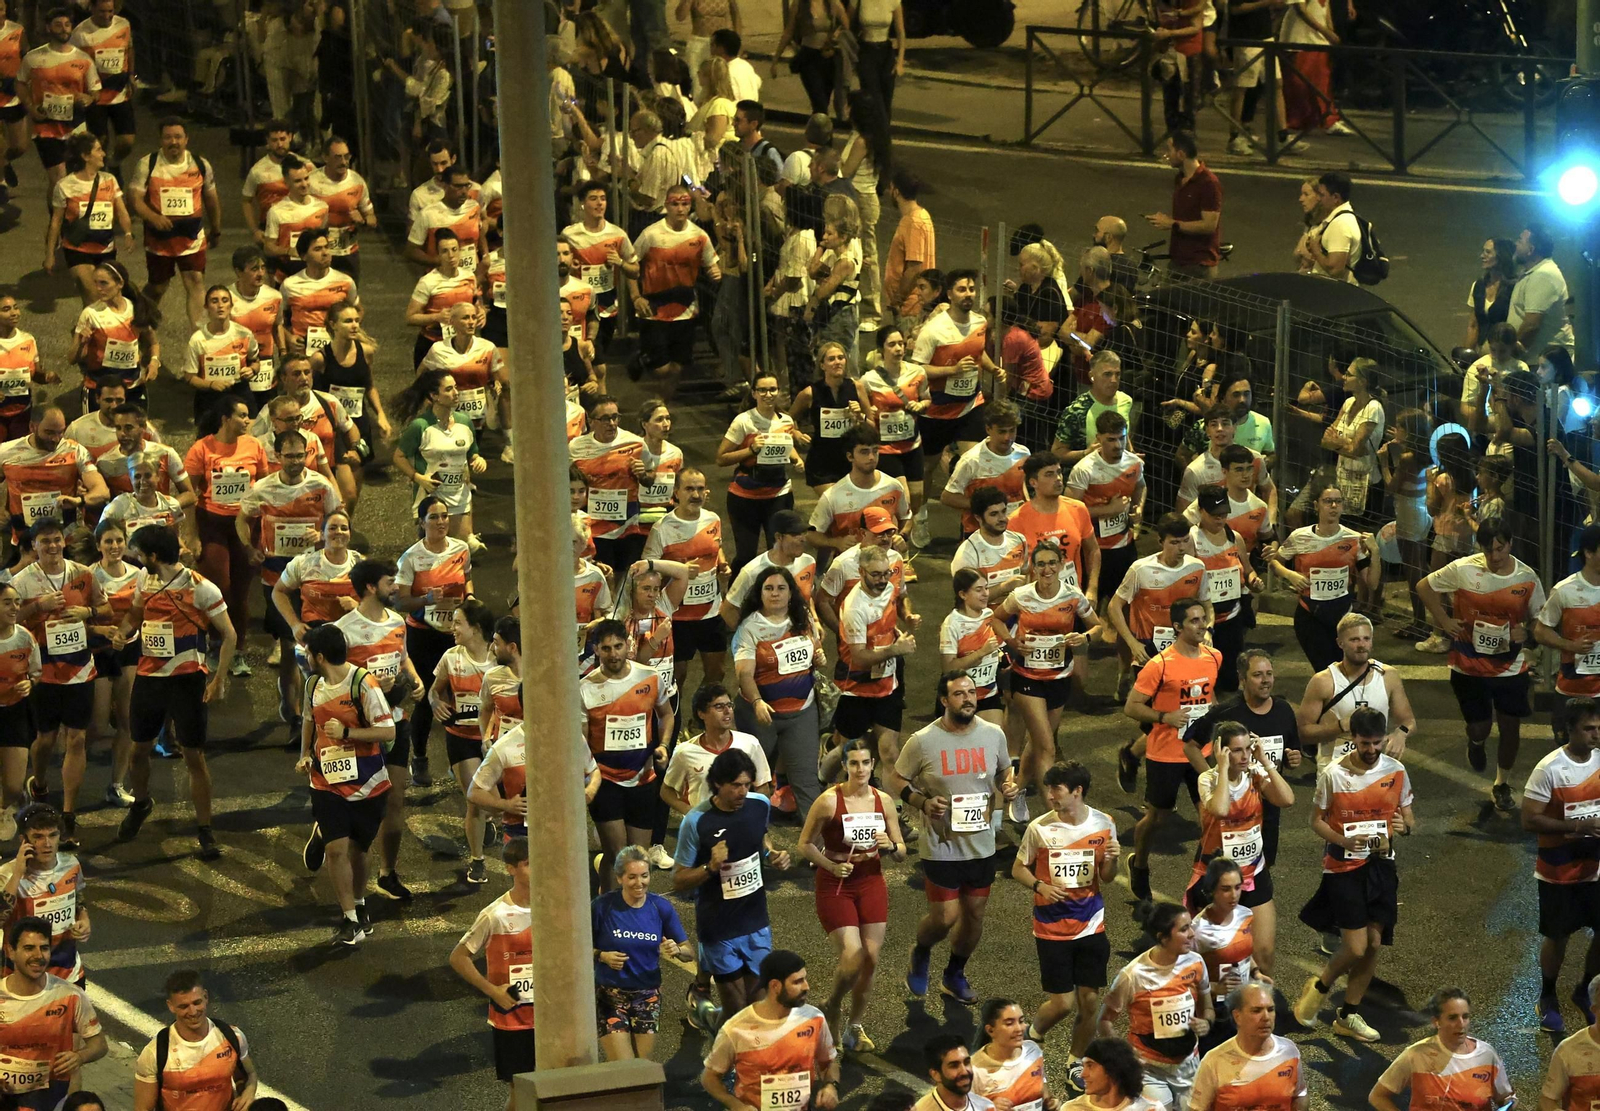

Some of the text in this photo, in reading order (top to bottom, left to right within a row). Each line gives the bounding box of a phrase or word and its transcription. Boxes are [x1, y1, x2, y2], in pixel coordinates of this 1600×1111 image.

[167, 199, 187, 208] 2331
[588, 275, 609, 286] 8536
[109, 350, 135, 360] 15265
[208, 366, 236, 376] 24128
[953, 379, 973, 388] 8391
[765, 446, 785, 455] 3699
[216, 484, 245, 495] 23074
[646, 485, 667, 495] 3700
[30, 506, 54, 517] 8467
[595, 502, 618, 512] 3709
[688, 583, 714, 596] 15821
[1214, 579, 1232, 589] 7118
[1315, 579, 1344, 591] 17892
[55, 631, 80, 645] 5349
[1479, 635, 1503, 646] 9588
[785, 649, 808, 663] 1829
[1030, 648, 1059, 659] 13196
[972, 666, 992, 678] 2147
[610, 729, 641, 741] 17853
[324, 760, 351, 774] 20838
[941, 747, 986, 776] LDN
[964, 809, 981, 821] 720
[852, 829, 876, 840] 3656
[1363, 836, 1380, 849] 00
[1232, 843, 1256, 857] 6499
[1054, 865, 1089, 876] 21575
[727, 870, 758, 888] 14995
[622, 930, 657, 941] ayesa
[1158, 1009, 1191, 1025] 18957
[3, 1073, 42, 1085] 21092
[772, 1091, 801, 1104] 5182
